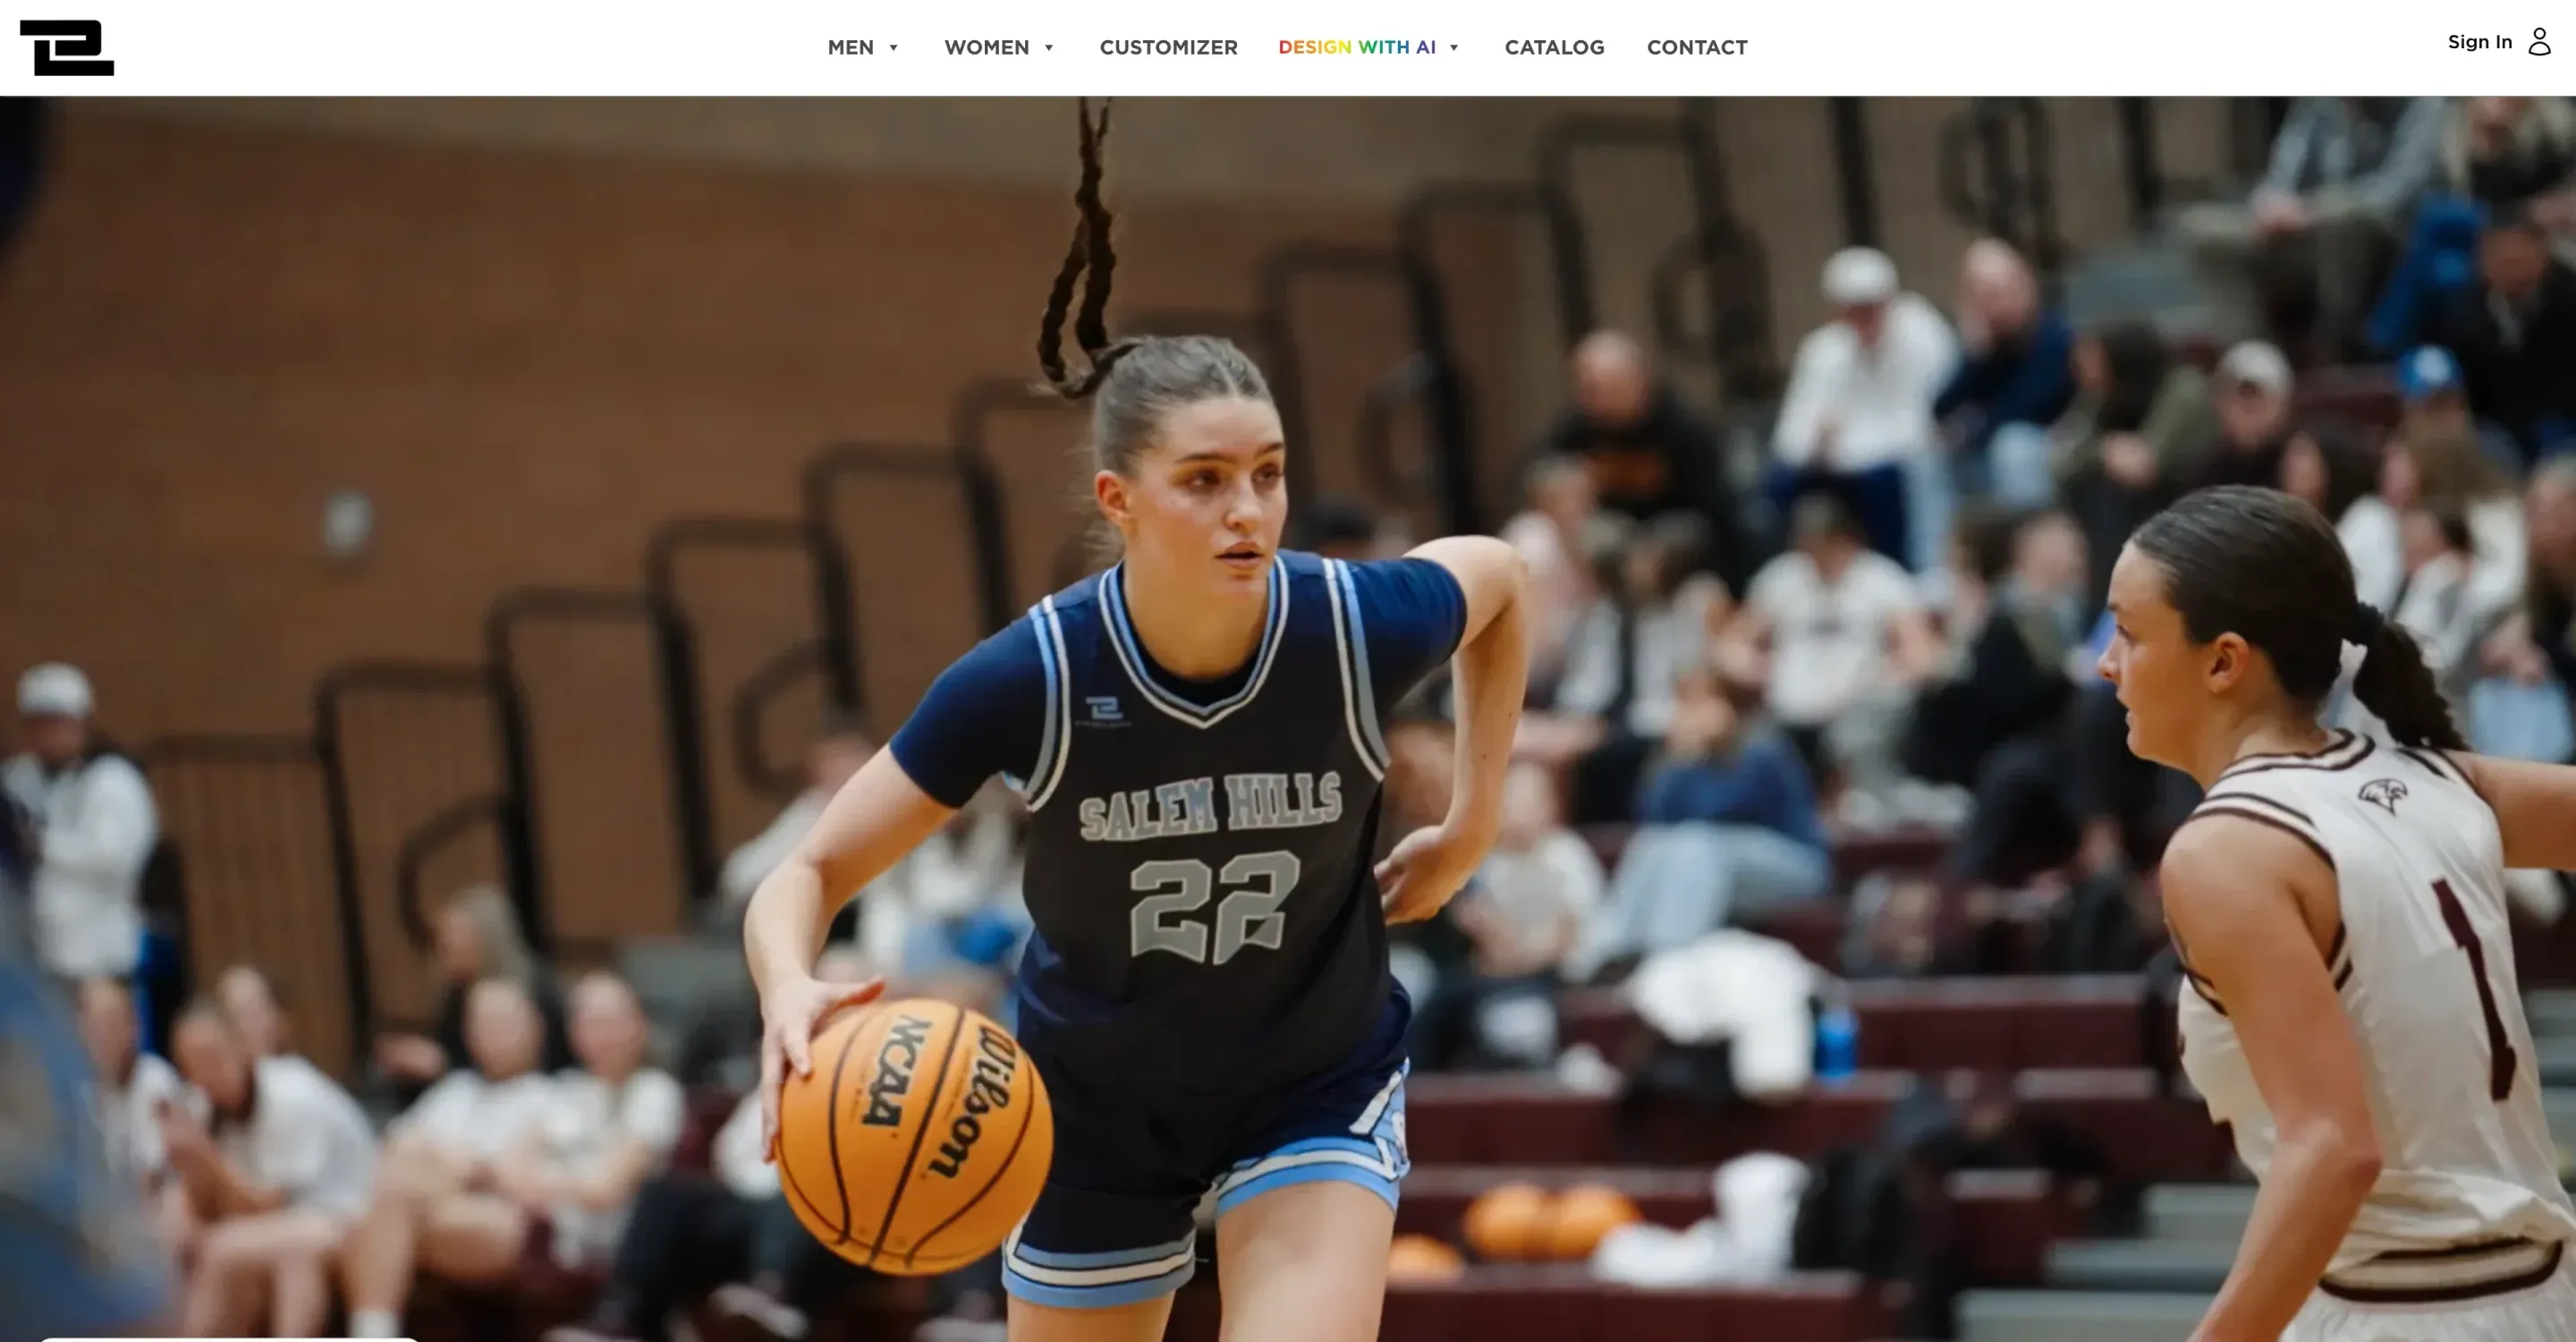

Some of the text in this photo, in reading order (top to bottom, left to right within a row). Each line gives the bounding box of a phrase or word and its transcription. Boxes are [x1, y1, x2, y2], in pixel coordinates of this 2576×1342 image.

[1079, 770, 1343, 842] SALEM HILLS
[1131, 850, 1301, 965] 22
[2431, 878, 2517, 1102] 1
[861, 1015, 933, 1127] NCAA
[928, 1023, 1018, 1180] Wilson
